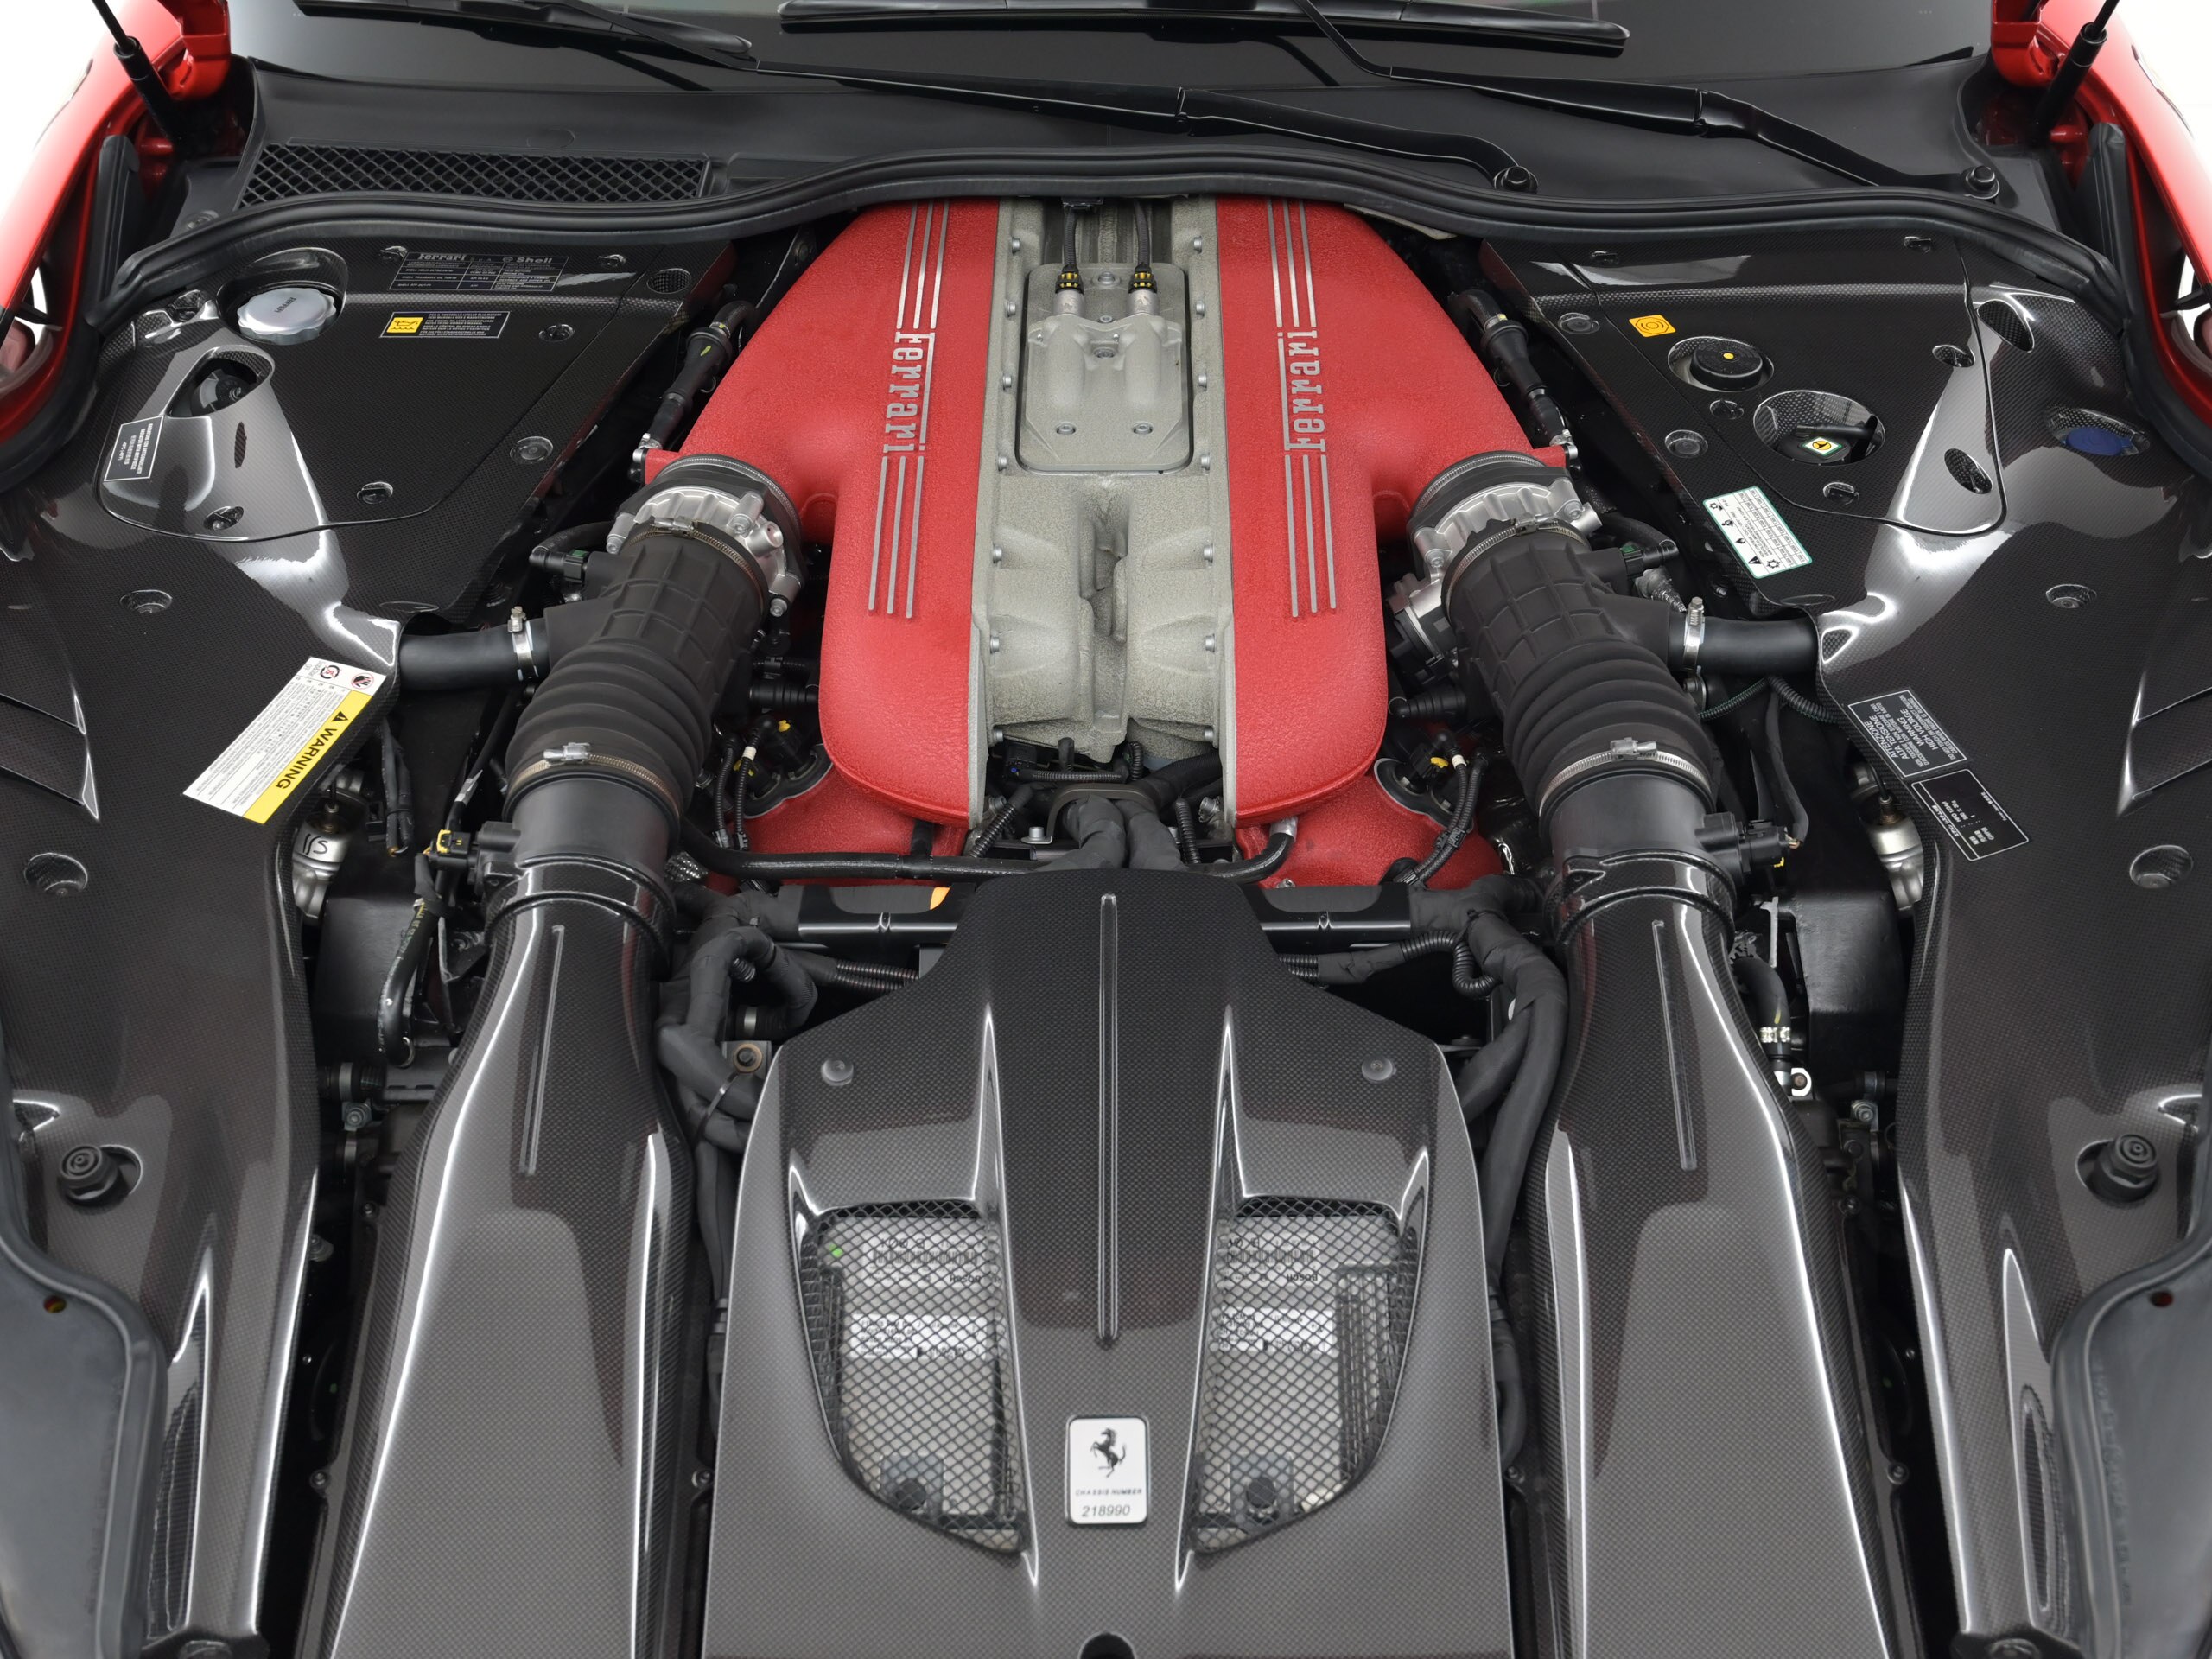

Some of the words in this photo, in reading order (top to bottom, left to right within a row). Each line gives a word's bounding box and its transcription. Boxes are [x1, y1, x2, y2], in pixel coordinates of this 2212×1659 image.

[883, 332, 935, 453] Ferrari
[1277, 329, 1326, 452] Ferrari
[1869, 715, 1898, 745] TENSIONE
[1897, 717, 1926, 746] WARNING
[1900, 709, 1926, 734] VOLTAGE
[1864, 721, 1899, 759] ATTENZIONE
[1893, 745, 1910, 760] ALTA
[1922, 734, 1939, 750] HIGH
[275, 727, 337, 790] WARNING
[1082, 1505, 1130, 1517] 218990
